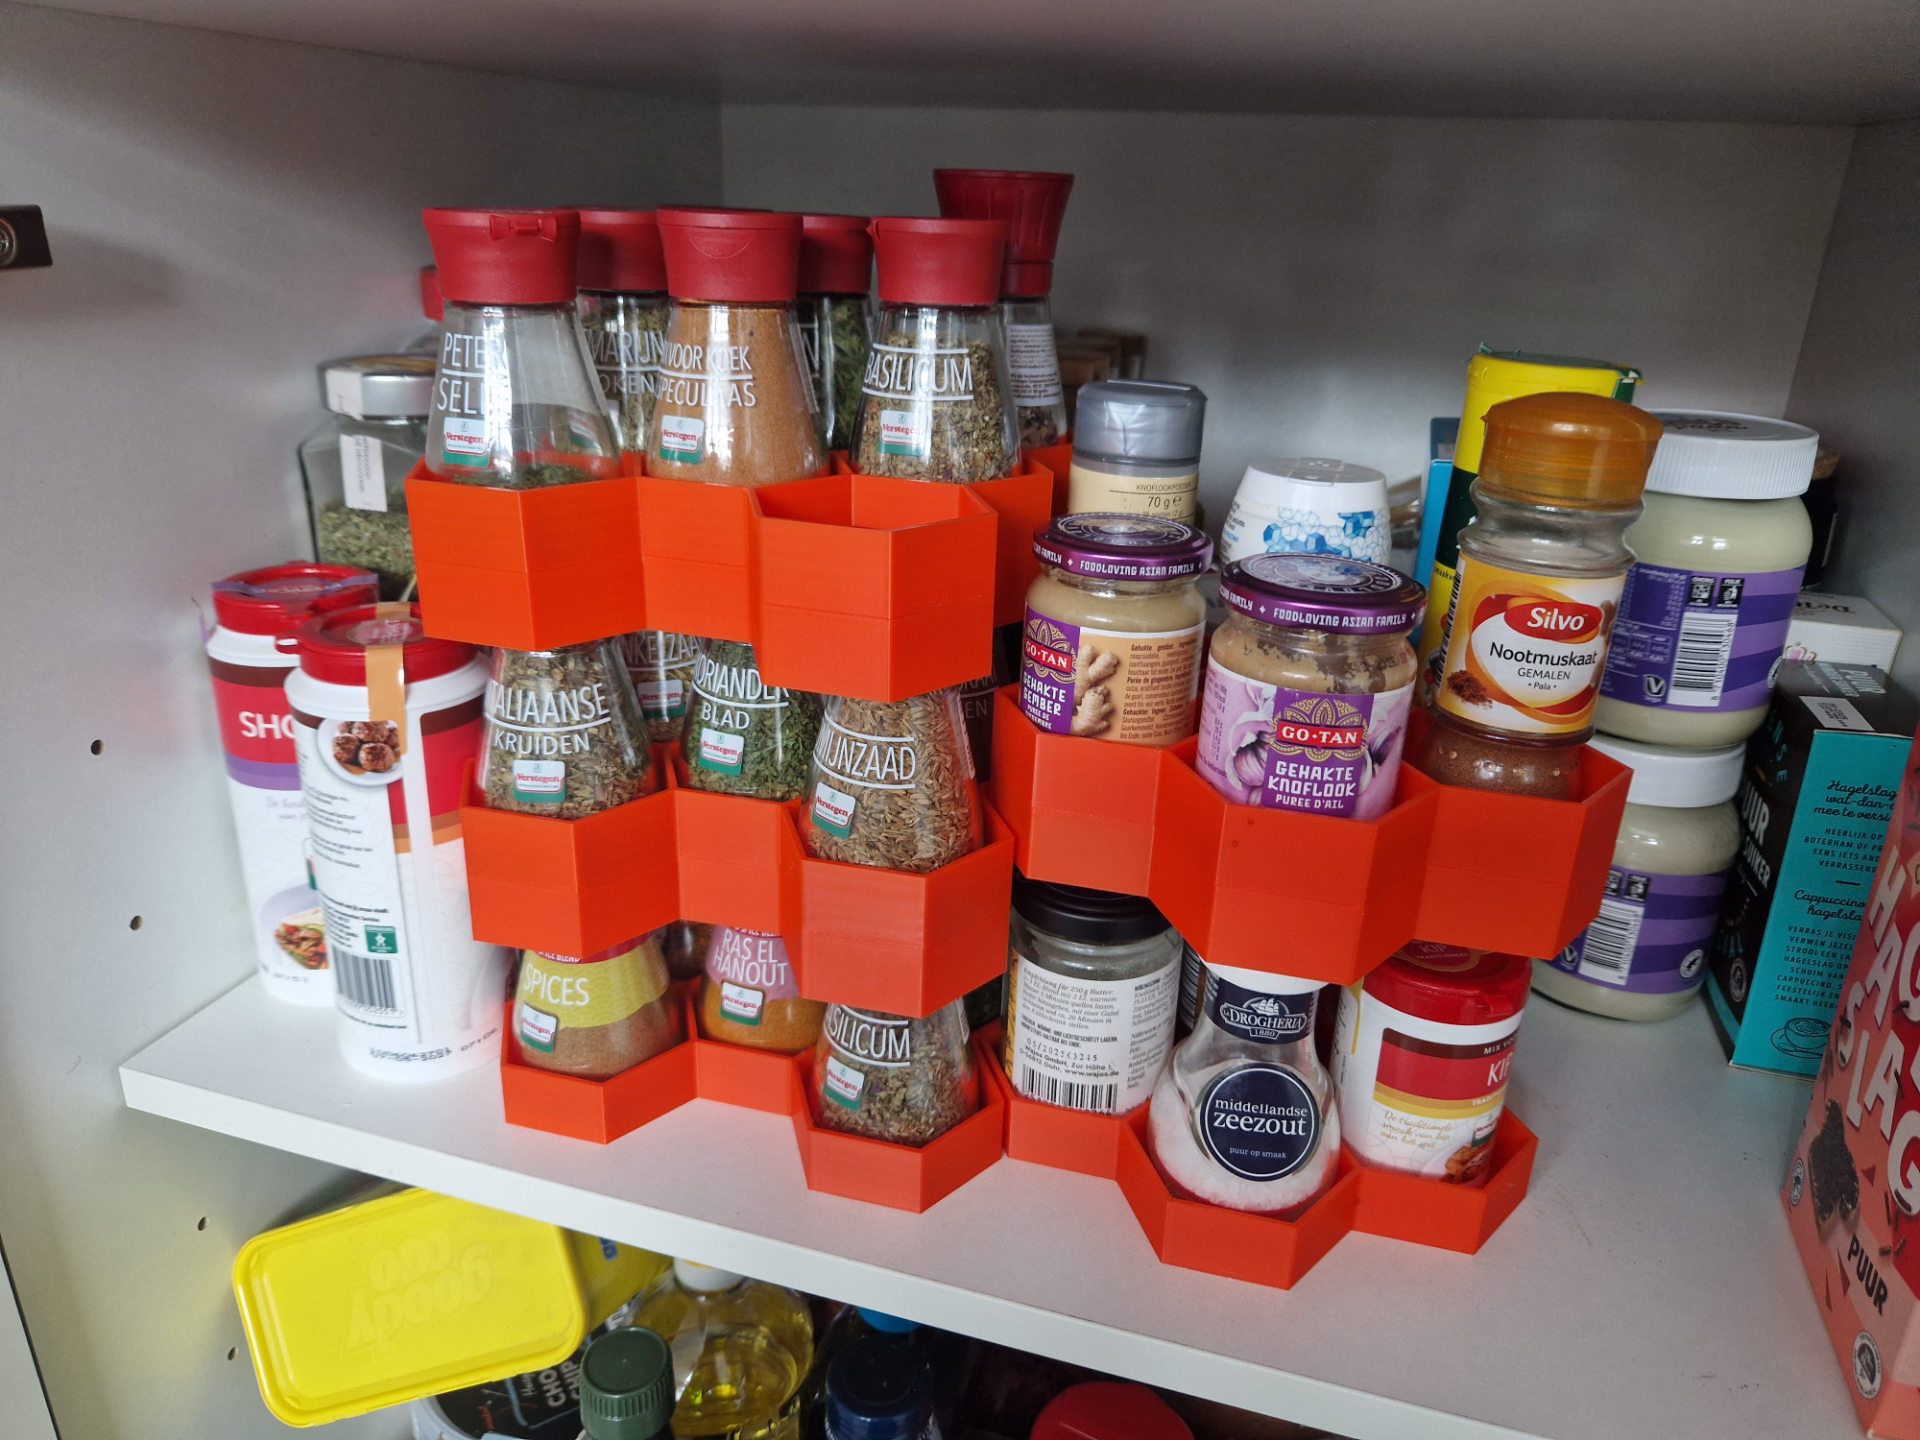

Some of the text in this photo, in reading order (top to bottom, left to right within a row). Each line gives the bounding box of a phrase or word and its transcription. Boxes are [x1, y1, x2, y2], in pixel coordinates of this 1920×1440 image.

[864, 351, 973, 393] BASILICUM
[446, 432, 484, 445] Verstegen
[663, 429, 697, 442] Verstegen
[1148, 496, 1160, 508] 70
[1041, 548, 1062, 564] FAMILY
[1080, 560, 1194, 576] FOODLOVING ASIAN FAMILY
[1230, 592, 1253, 611] FAMILY
[1274, 607, 1406, 628] FOODLOVING ASIAN FAMILY
[1527, 607, 1585, 631] Silvo
[1489, 642, 1598, 667] Nootmuskaat
[1517, 667, 1571, 680] GEMALEN
[1023, 671, 1066, 703] GEHAKTE
[1023, 687, 1061, 716] GEMBER
[701, 702, 750, 729] BLAD
[494, 729, 590, 755] KRUIDEN
[703, 741, 737, 755] Verstegen
[517, 773, 559, 783] Verstegen
[1275, 760, 1354, 781] GEHAKTE
[1268, 776, 1355, 797] KNOFLOOK
[1827, 780, 1897, 800] Hagelslag
[817, 796, 848, 817] Verstegen
[1276, 793, 1344, 809] PUREE D'AIL
[1813, 807, 1891, 822] mee te versi
[1825, 828, 1867, 839] HEERLIJK
[1804, 836, 1868, 849] BOTERHAM OF
[1813, 848, 1879, 862] EENS IETS AND
[1794, 889, 1866, 908] Cappuccino
[1807, 904, 1862, 921] hagelsla
[1788, 925, 1821, 936] VERRAS
[1837, 932, 1856, 940] VISI
[722, 929, 752, 961] RAS
[757, 940, 778, 963] EL
[1419, 944, 1446, 953] KIP
[1789, 936, 1853, 950] VERWEN JEZEL
[1785, 945, 1817, 955] STROOI
[1820, 950, 1836, 958] EEN
[714, 945, 787, 986] HANOUT
[1783, 956, 1849, 970] HAGELSLAG OP
[1789, 966, 1844, 980] SCHUIM VAN
[523, 963, 590, 1006] SPICES
[1776, 985, 1826, 997] FEESTELIJK
[722, 994, 757, 1009] Verstegen
[1775, 994, 1837, 1009] SMAAKT HEER
[1230, 1008, 1303, 1029] DROGHERIA
[1254, 1029, 1275, 1038] 1880
[1484, 1044, 1501, 1055] MIX
[1214, 1098, 1308, 1117] middellandse
[1213, 1111, 1307, 1136] zeezout
[1383, 1110, 1397, 1122] De
[1229, 1147, 1287, 1159] puur op smaak
[1847, 1232, 1888, 1316] PUUR
[539, 1369, 567, 1407] CHO
